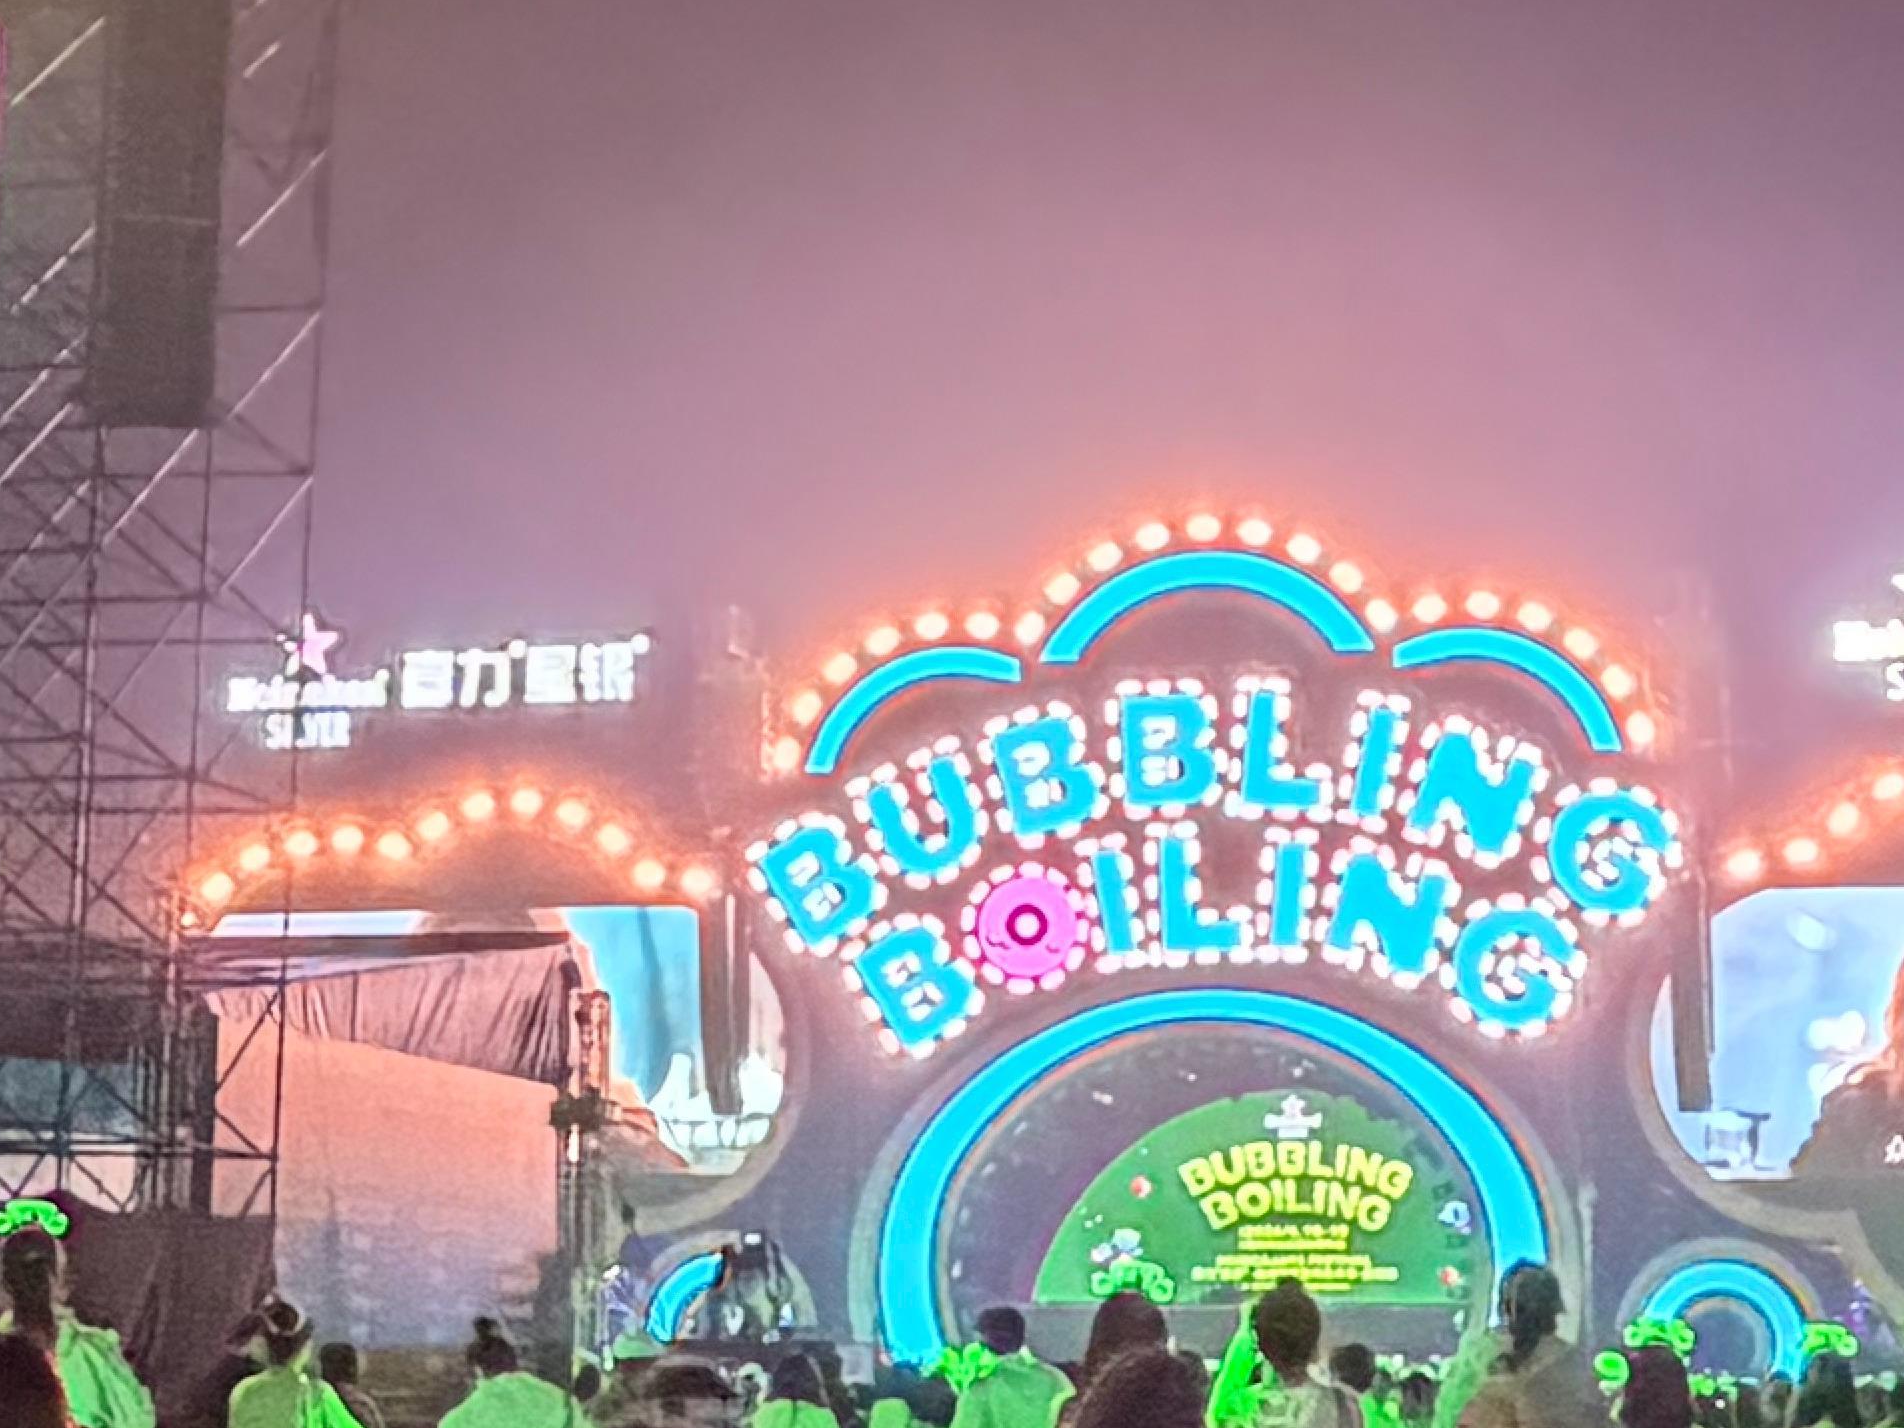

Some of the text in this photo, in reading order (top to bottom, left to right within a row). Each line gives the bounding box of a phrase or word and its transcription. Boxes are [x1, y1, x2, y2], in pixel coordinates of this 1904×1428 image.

[746, 676, 1683, 954] BUBBLING
[846, 820, 1586, 1059] BOILING
[1177, 1139, 1414, 1200] BUBBLING
[1199, 1177, 1392, 1232] BOILING
